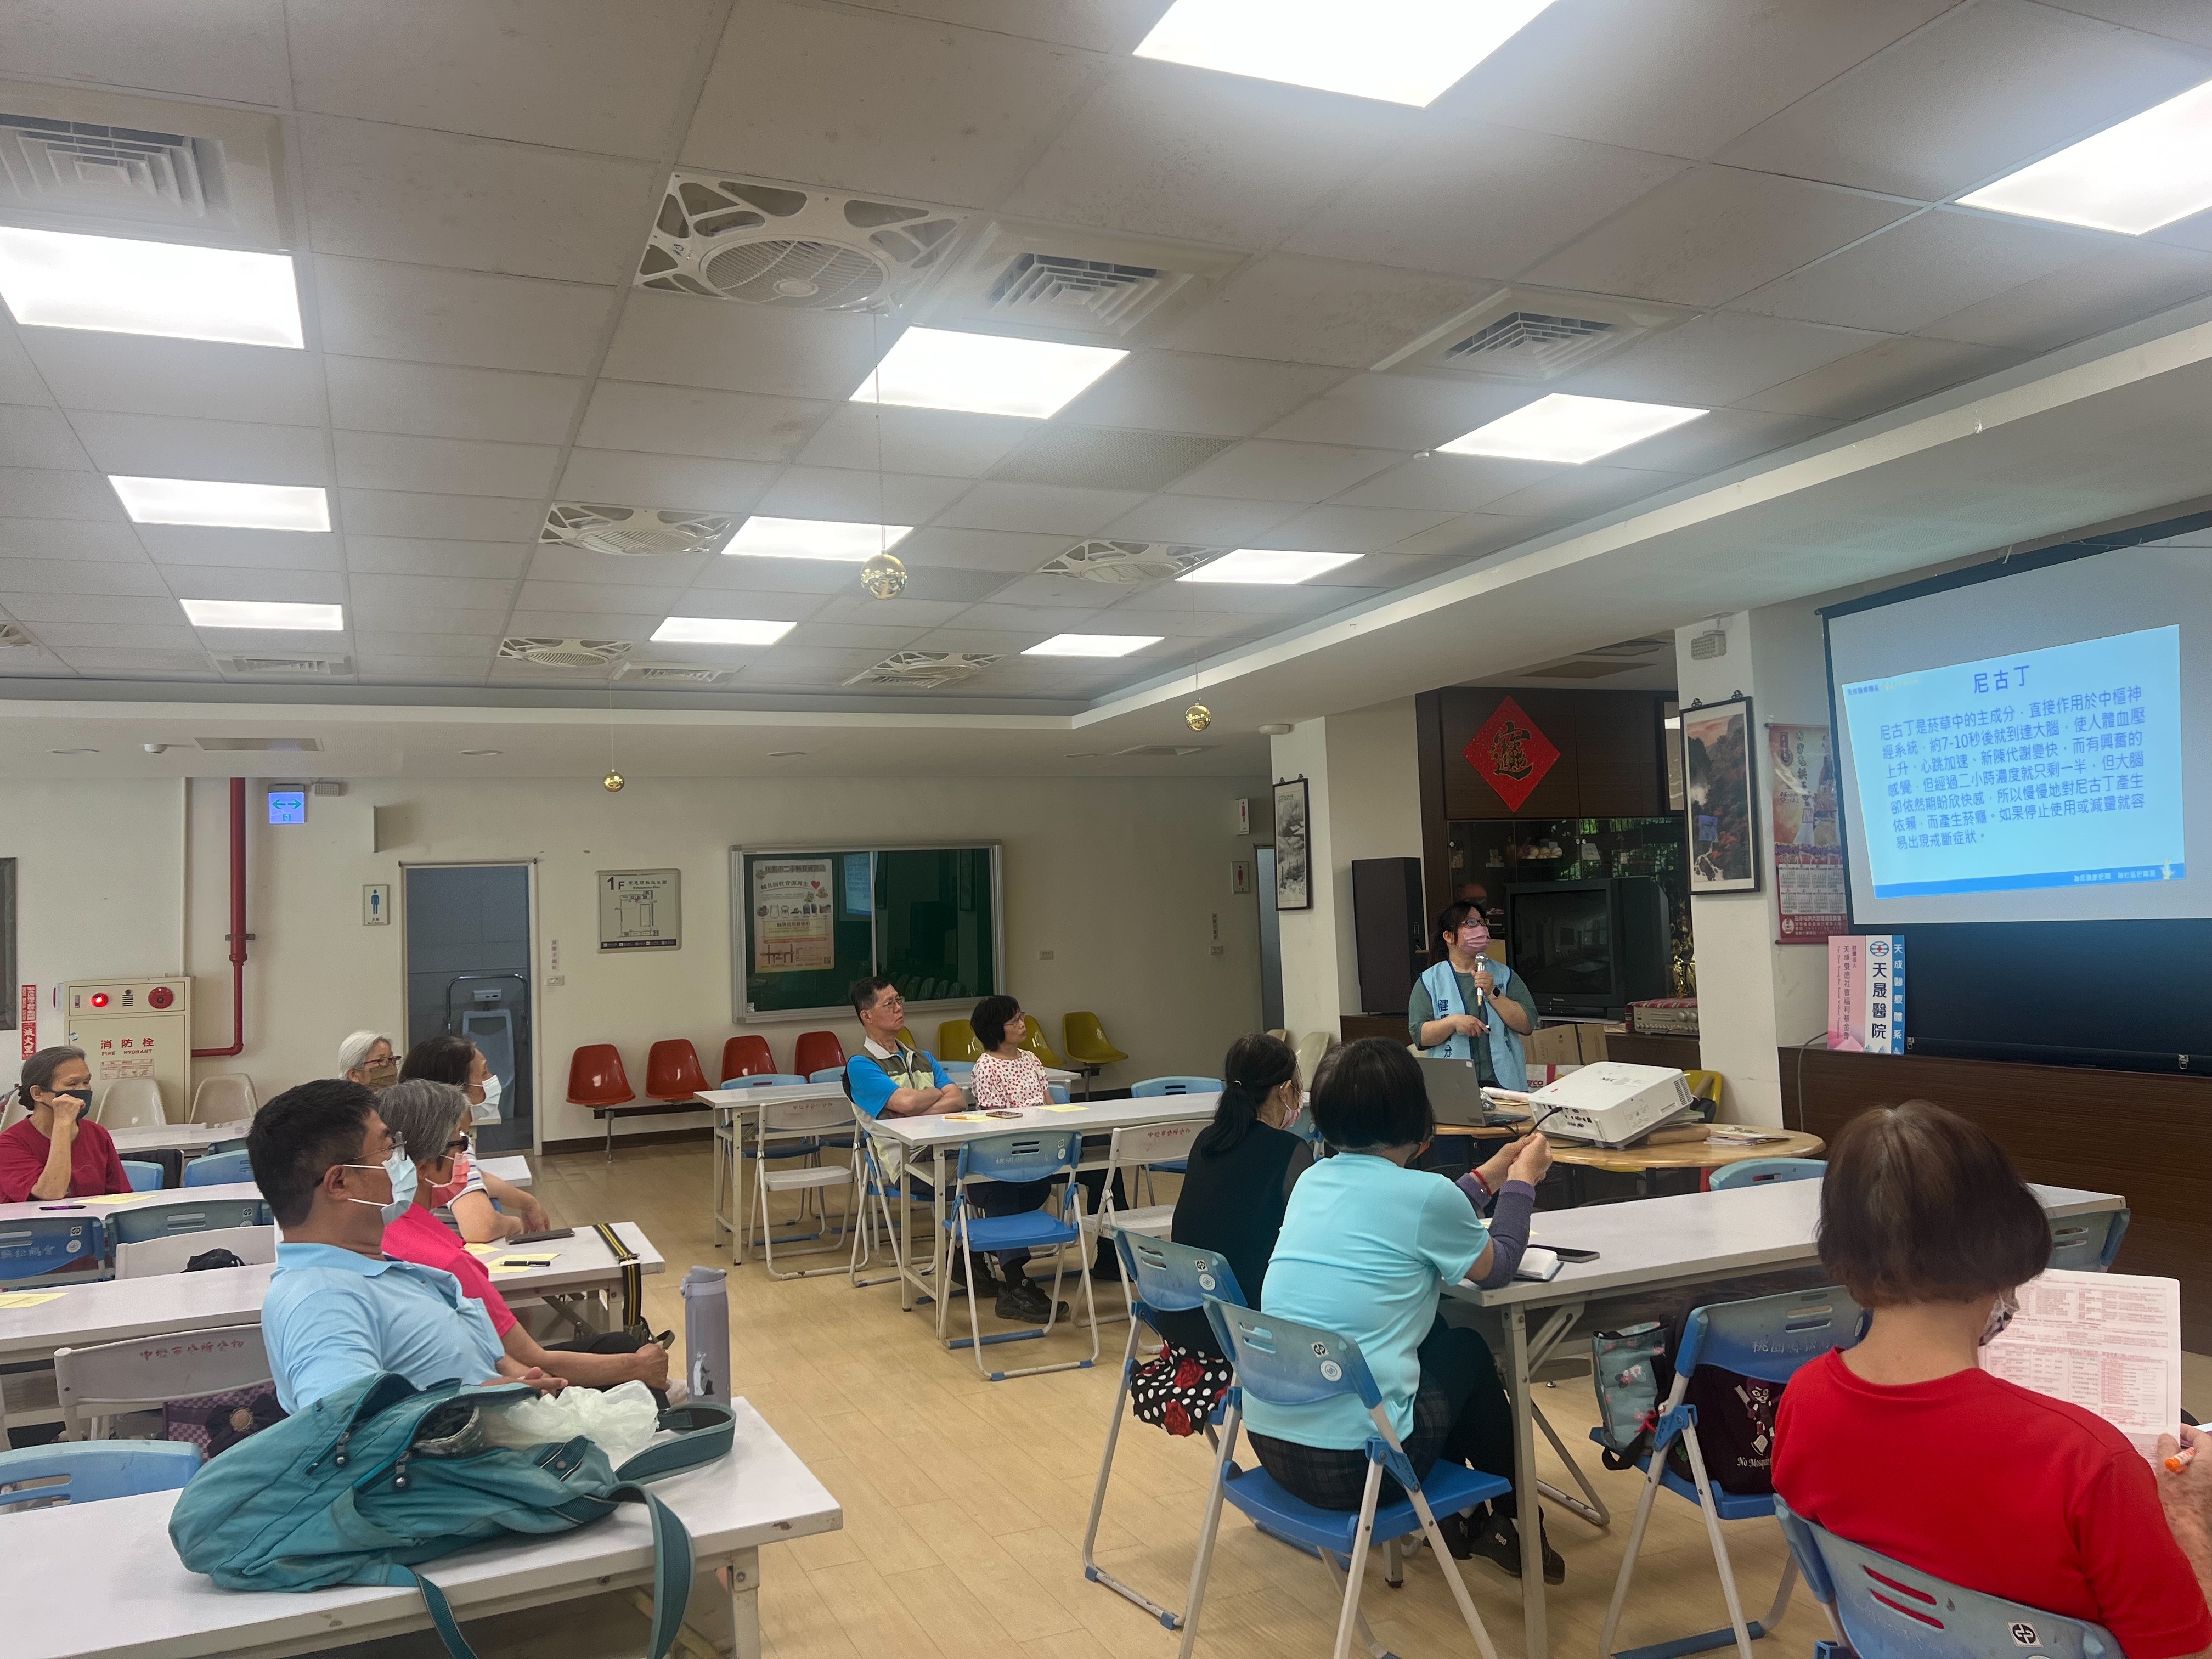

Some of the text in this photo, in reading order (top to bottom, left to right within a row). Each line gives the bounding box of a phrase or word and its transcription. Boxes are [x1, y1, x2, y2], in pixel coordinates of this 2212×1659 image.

[1973, 664, 2029, 694] 尼古丁
[607, 877, 625, 890] 1 F
[1871, 962, 1887, 1039] 天晟醫院
[101, 1037, 154, 1049] 消防栓
[1737, 1457, 1748, 1466] No
